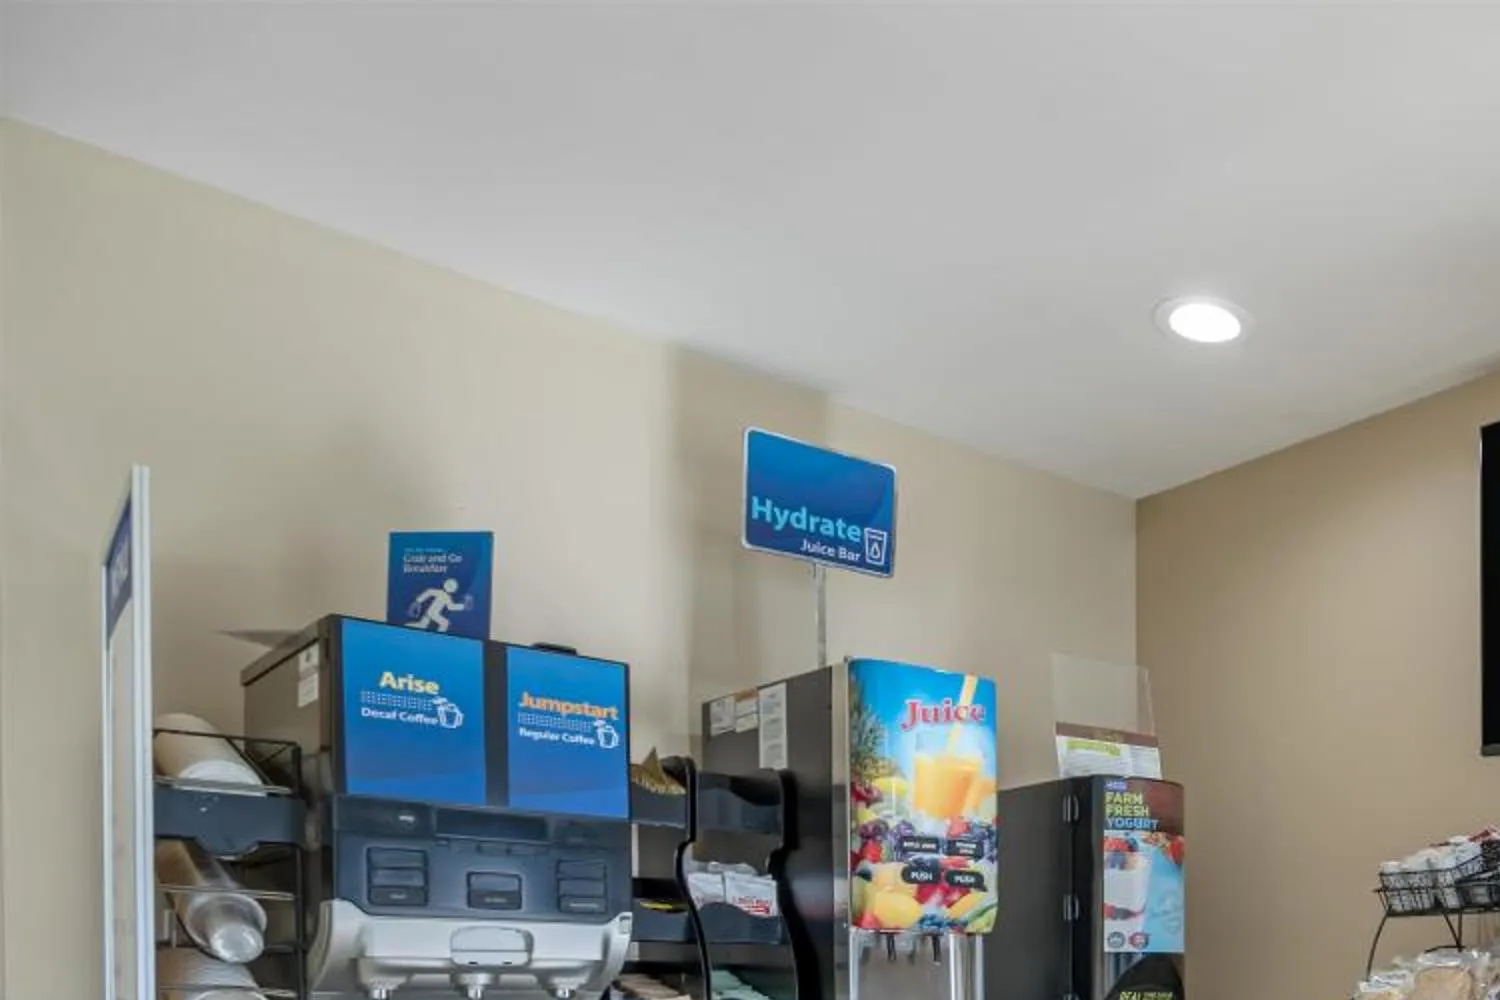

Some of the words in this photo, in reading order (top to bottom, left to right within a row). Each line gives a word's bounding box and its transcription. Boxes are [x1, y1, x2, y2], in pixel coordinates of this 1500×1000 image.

[752, 496, 862, 543] Hydrate
[800, 538, 836, 558] Juice
[838, 546, 862, 562] Bar
[378, 671, 440, 695] Arise
[518, 691, 619, 720] Jumpstart
[901, 699, 986, 731] Juice
[360, 706, 397, 721] Decaf
[399, 710, 438, 726] Coffee
[518, 727, 559, 742] Regular
[561, 733, 595, 747] Coffee
[1105, 792, 1144, 804] FARM
[1105, 804, 1149, 817] FRESH
[1106, 817, 1160, 830] YOGURT
[910, 871, 933, 882] PUSH
